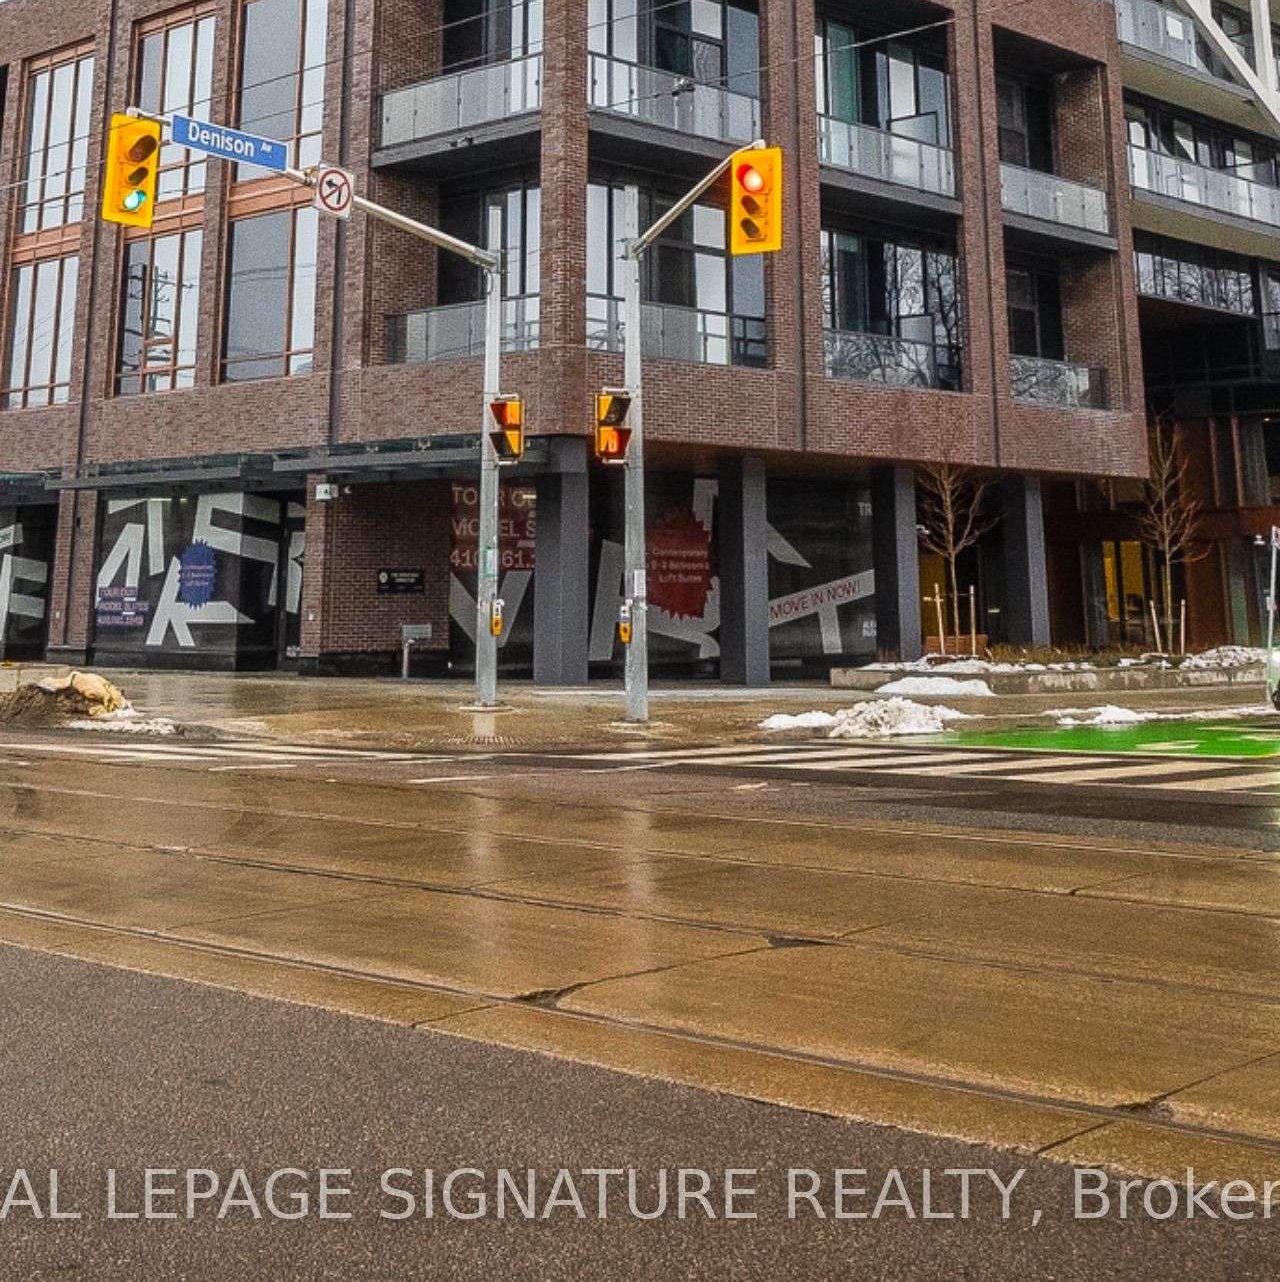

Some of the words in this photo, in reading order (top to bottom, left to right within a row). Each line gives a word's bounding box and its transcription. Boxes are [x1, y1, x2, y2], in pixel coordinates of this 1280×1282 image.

[187, 121, 255, 158] Denison
[769, 595, 808, 618] MOVE
[810, 593, 823, 606] IN
[827, 580, 861, 601] NOW!
